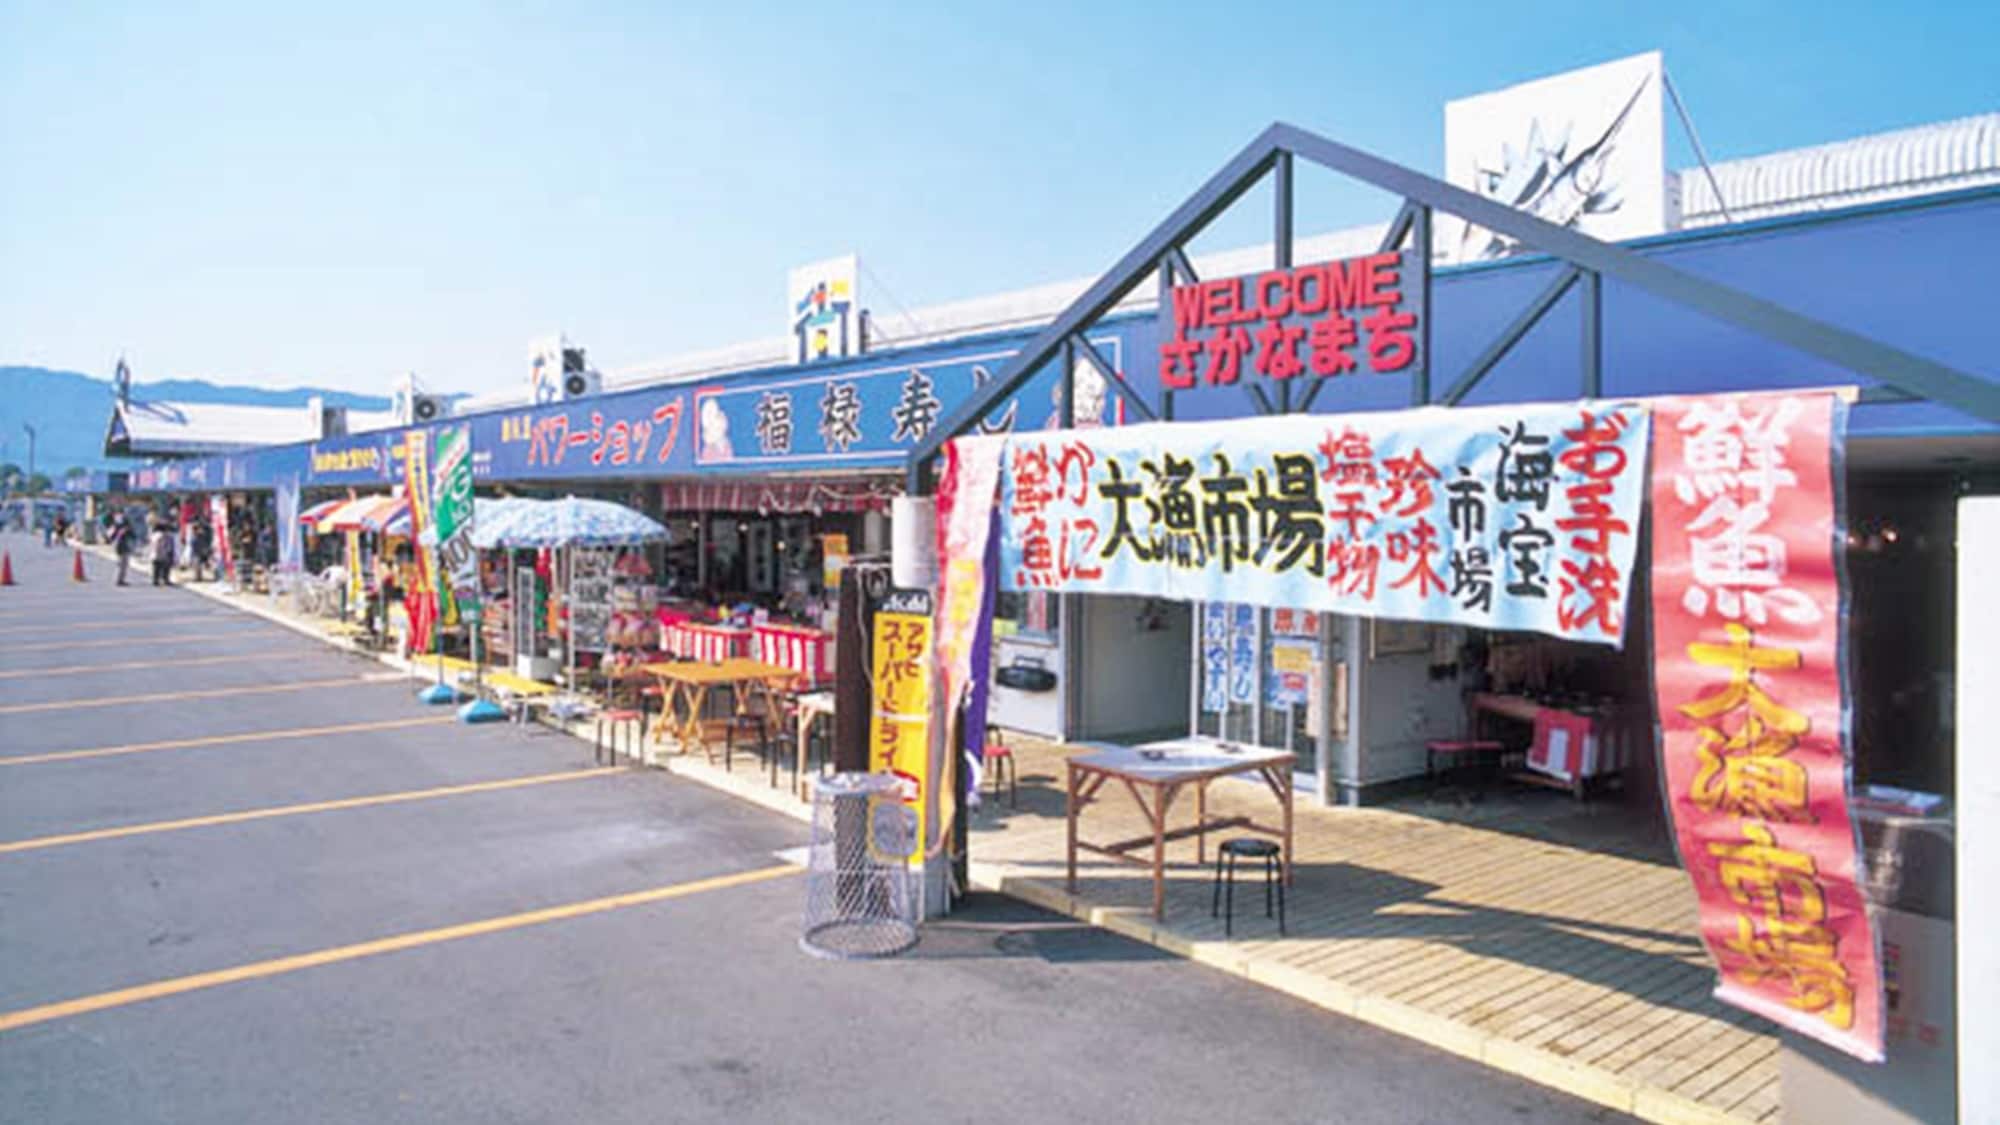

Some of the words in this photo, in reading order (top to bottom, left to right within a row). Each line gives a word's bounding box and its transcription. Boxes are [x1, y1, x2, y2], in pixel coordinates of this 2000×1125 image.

[1159, 306, 1418, 389] さかなまち
[1172, 252, 1402, 329] WELCOME
[527, 395, 684, 465] パワーショップ
[1011, 442, 1055, 588] 鮮魚
[1053, 440, 1103, 581] かに
[1097, 450, 1326, 579] 大漁市場
[1317, 424, 1382, 601] 塩干物
[1378, 447, 1448, 598] 珍味
[1445, 465, 1494, 614] 市場
[1495, 419, 1555, 600] 海宝
[904, 621, 925, 678] アサヒ
